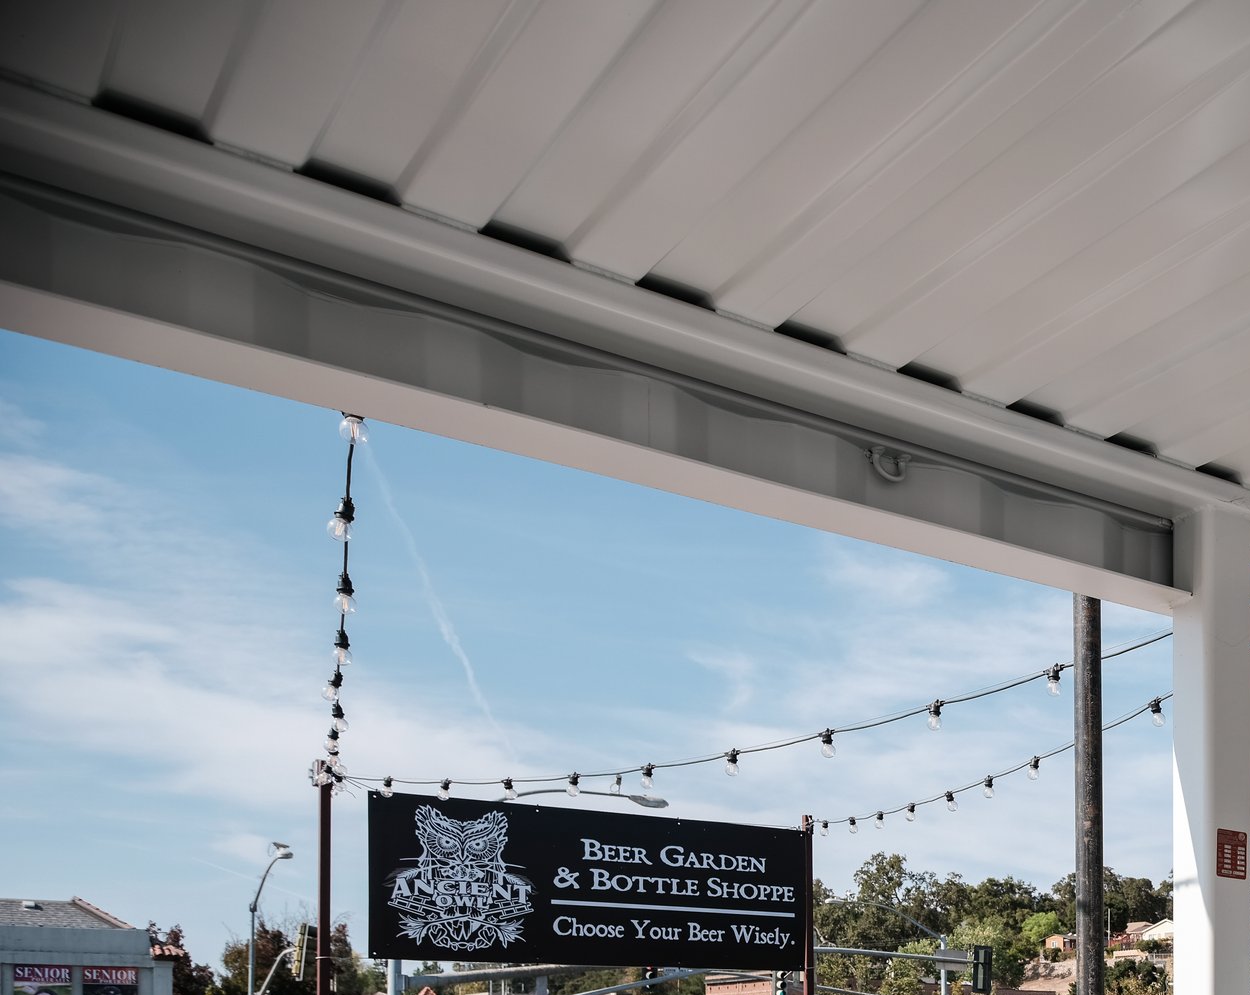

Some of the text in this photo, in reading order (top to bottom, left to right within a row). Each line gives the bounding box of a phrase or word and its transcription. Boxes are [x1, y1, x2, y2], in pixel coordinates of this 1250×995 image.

[580, 838, 766, 874] BEER GARDEN
[391, 878, 532, 904] ANCIENT
[553, 866, 795, 903] & BOTTLE SHOPPE
[435, 894, 490, 909] OWL
[552, 915, 796, 950] Choose Your Beer Wisely.
[15, 966, 70, 979] SENIOR
[84, 969, 136, 981] SENIOR
